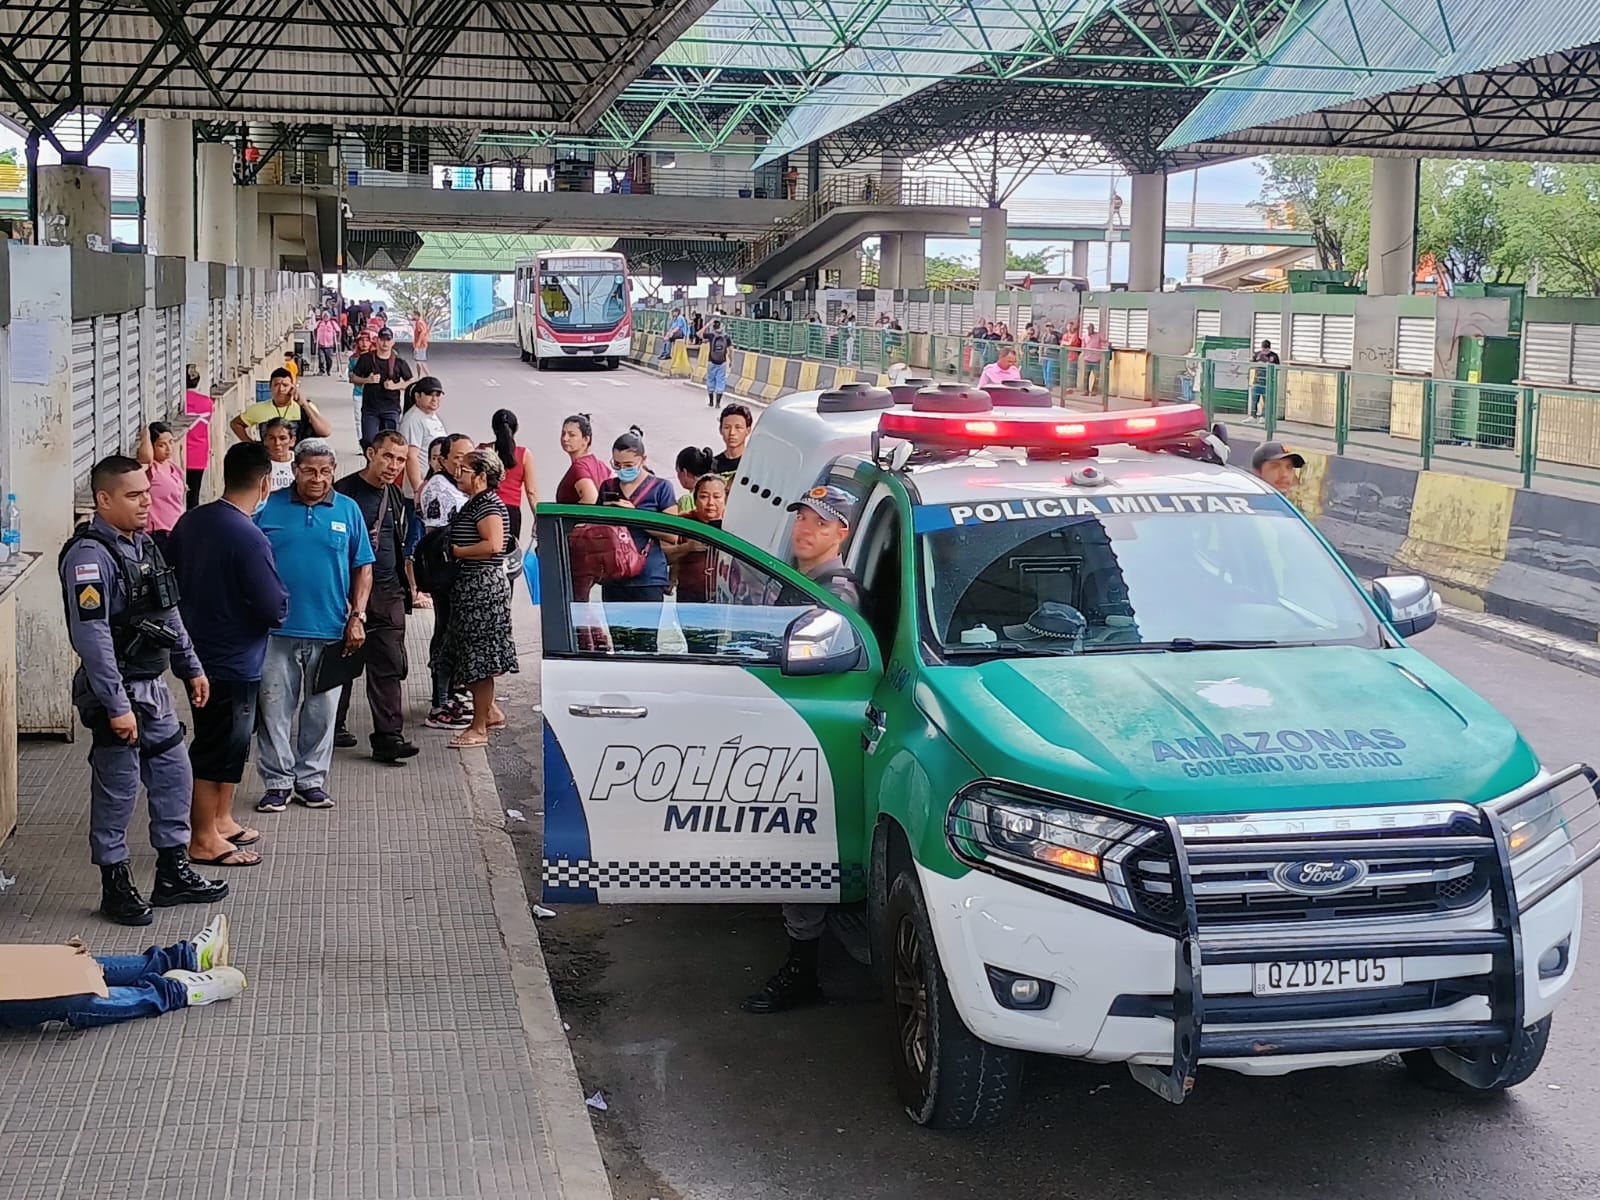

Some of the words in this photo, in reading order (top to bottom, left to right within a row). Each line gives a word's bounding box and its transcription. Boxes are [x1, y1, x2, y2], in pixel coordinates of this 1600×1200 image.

[950, 498, 1102, 526] POLÍCIA
[1107, 494, 1256, 514] MILITAR
[1151, 729, 1407, 762] AMAZONAS
[588, 735, 819, 804] POLÍCIA
[1181, 755, 1284, 778] GOVERNO
[1288, 753, 1319, 771] DO
[1319, 751, 1403, 770] ESTADO
[663, 805, 819, 835] MILITAR
[1191, 812, 1441, 836] RANGER
[1299, 861, 1345, 884] Ford
[1268, 958, 1386, 989] QZD2F05
